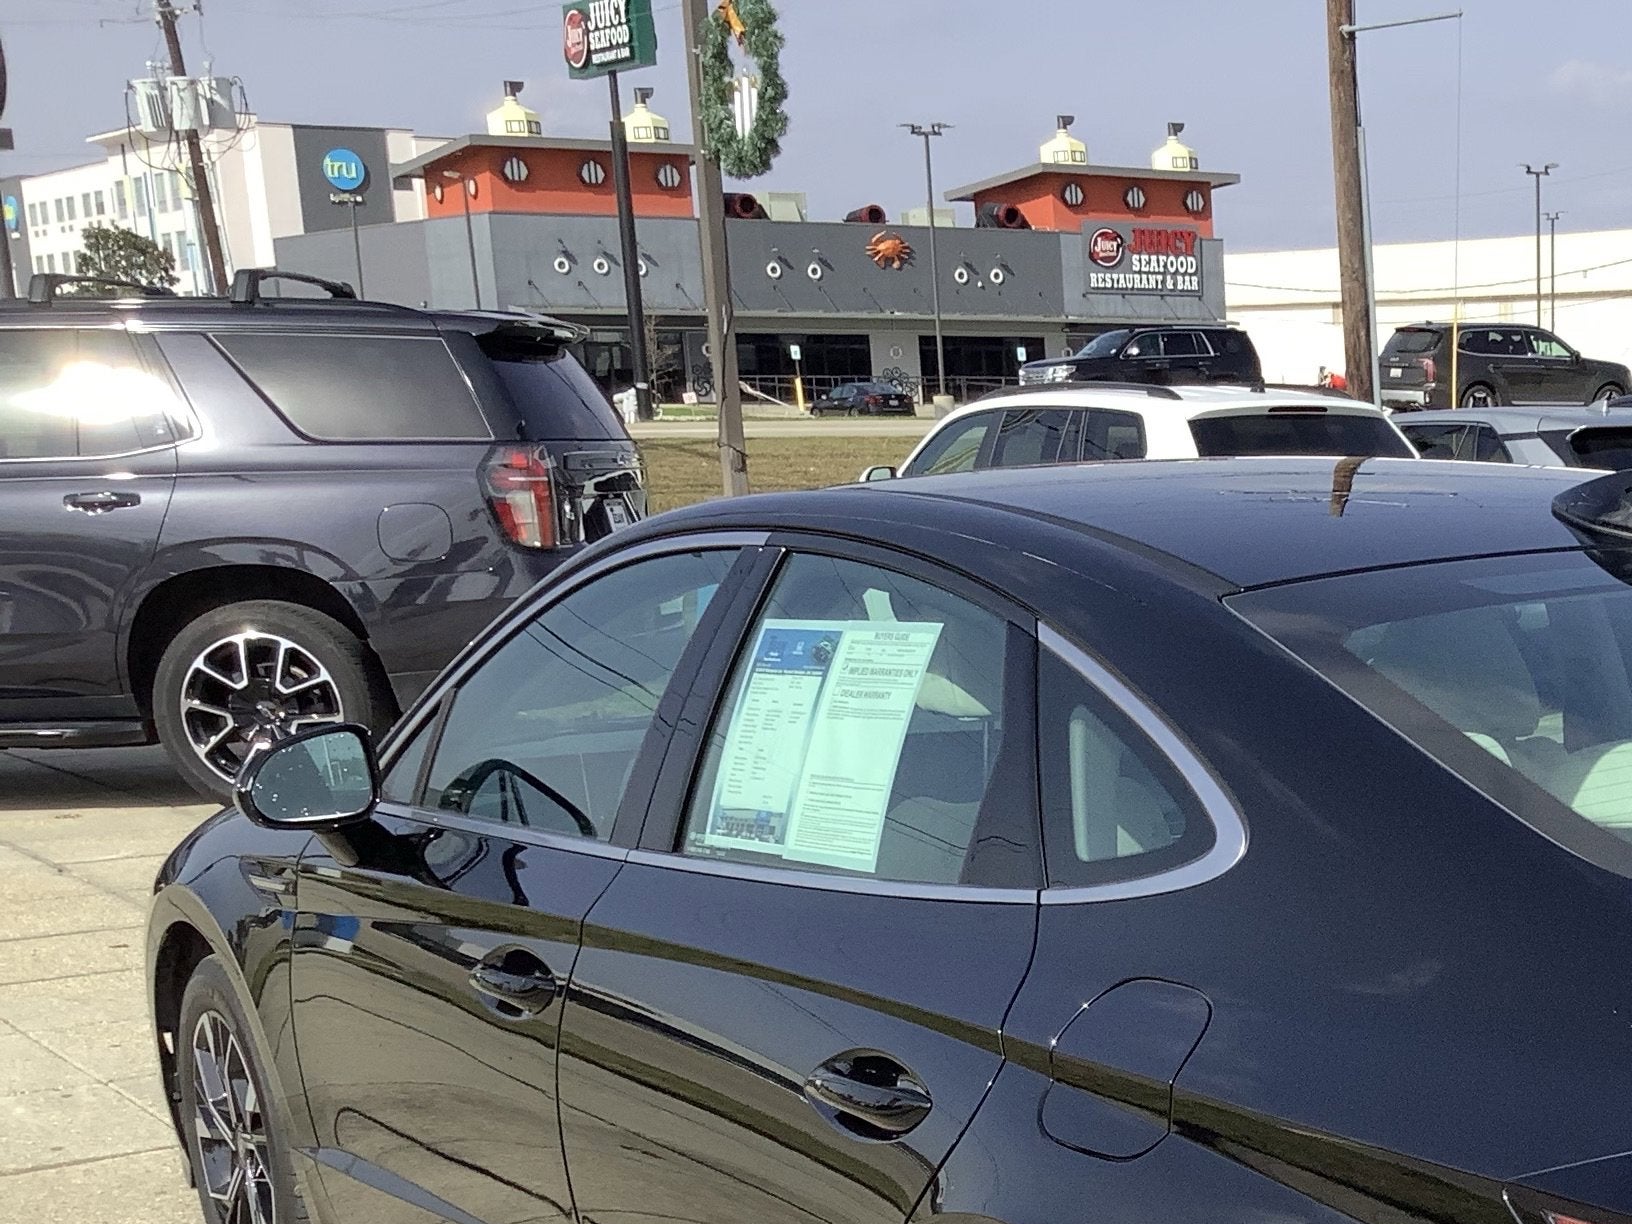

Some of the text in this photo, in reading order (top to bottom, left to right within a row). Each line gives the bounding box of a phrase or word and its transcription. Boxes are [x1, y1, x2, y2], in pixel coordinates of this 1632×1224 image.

[587, 0, 627, 31] JUICY
[588, 24, 630, 50] SEAFOOD
[323, 155, 357, 179] tru
[1127, 227, 1196, 256] JUICY
[1131, 254, 1197, 274] SEAFOOD
[1089, 272, 1199, 291] RESTAURANT & BAR
